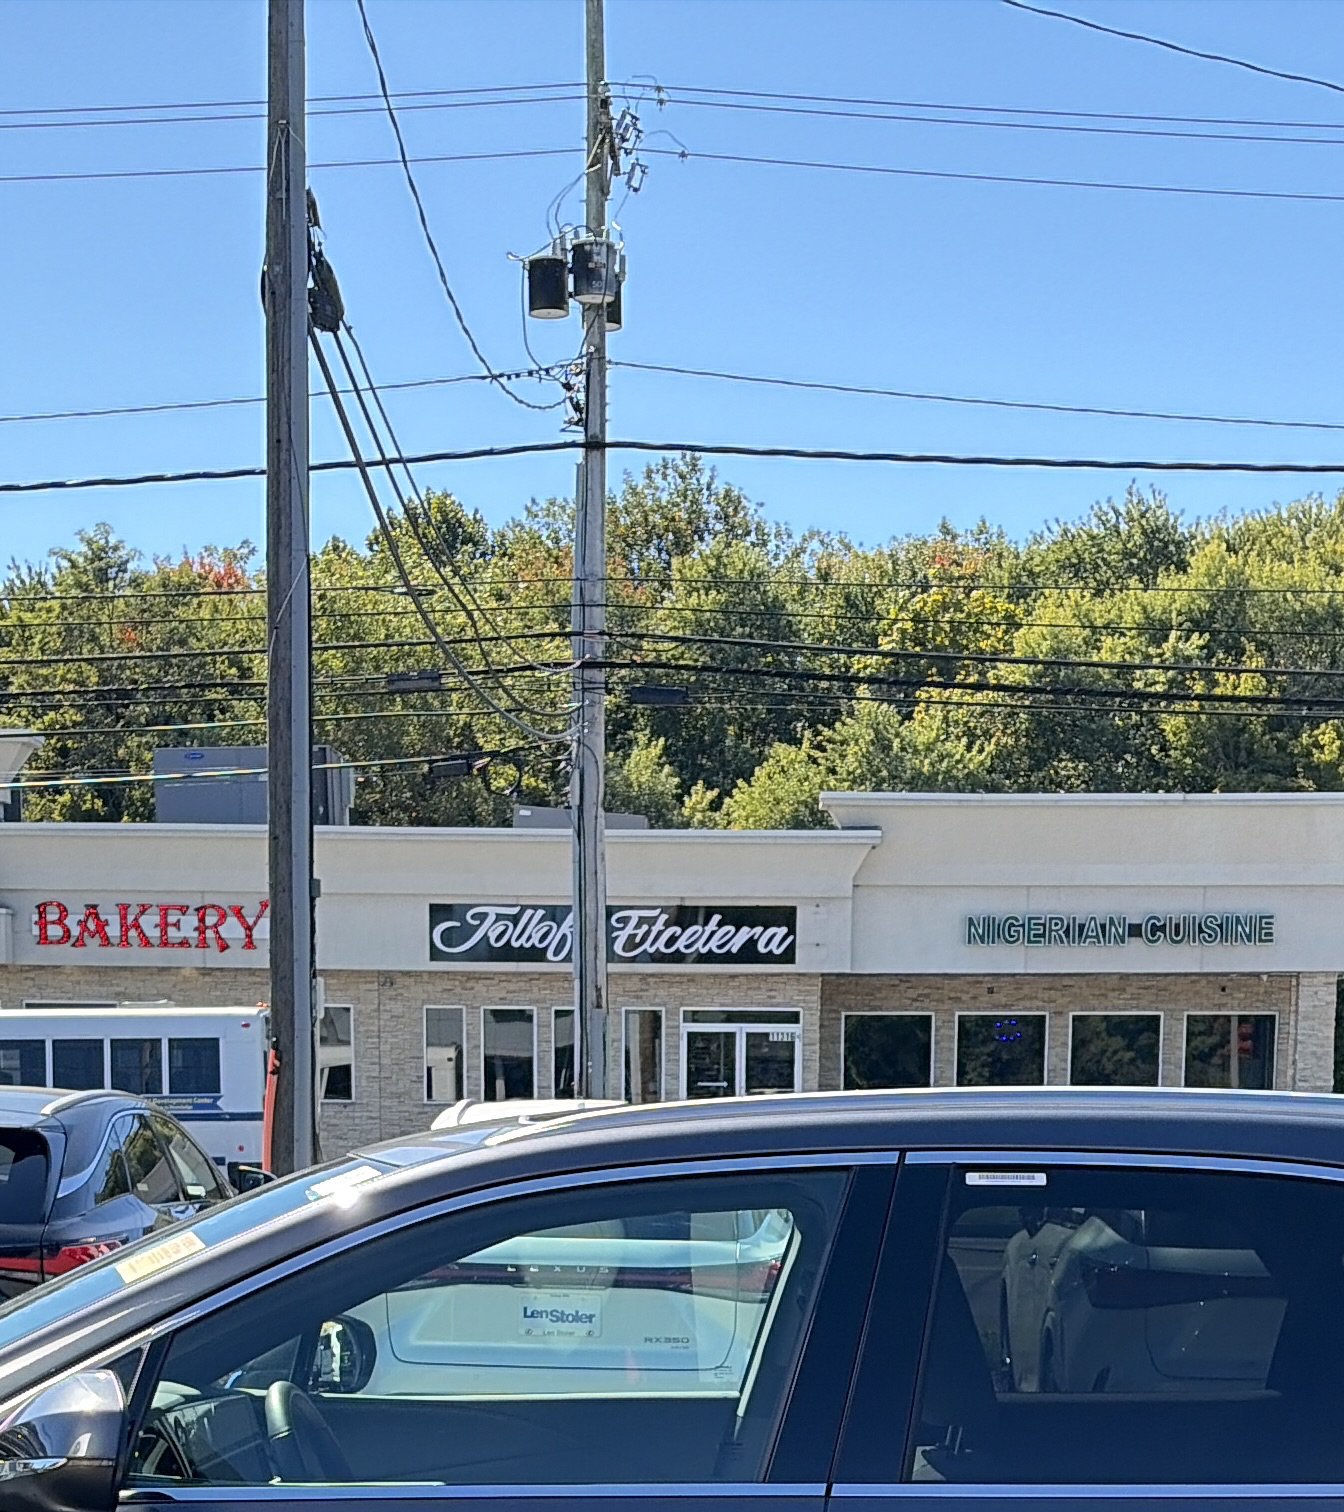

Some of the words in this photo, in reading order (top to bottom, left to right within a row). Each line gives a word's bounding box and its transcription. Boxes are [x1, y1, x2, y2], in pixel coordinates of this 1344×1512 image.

[34, 899, 270, 953] BAKERY
[610, 907, 794, 958] Etcetera
[965, 914, 1129, 947] NIGERIAN
[1141, 913, 1276, 946] CUISINE
